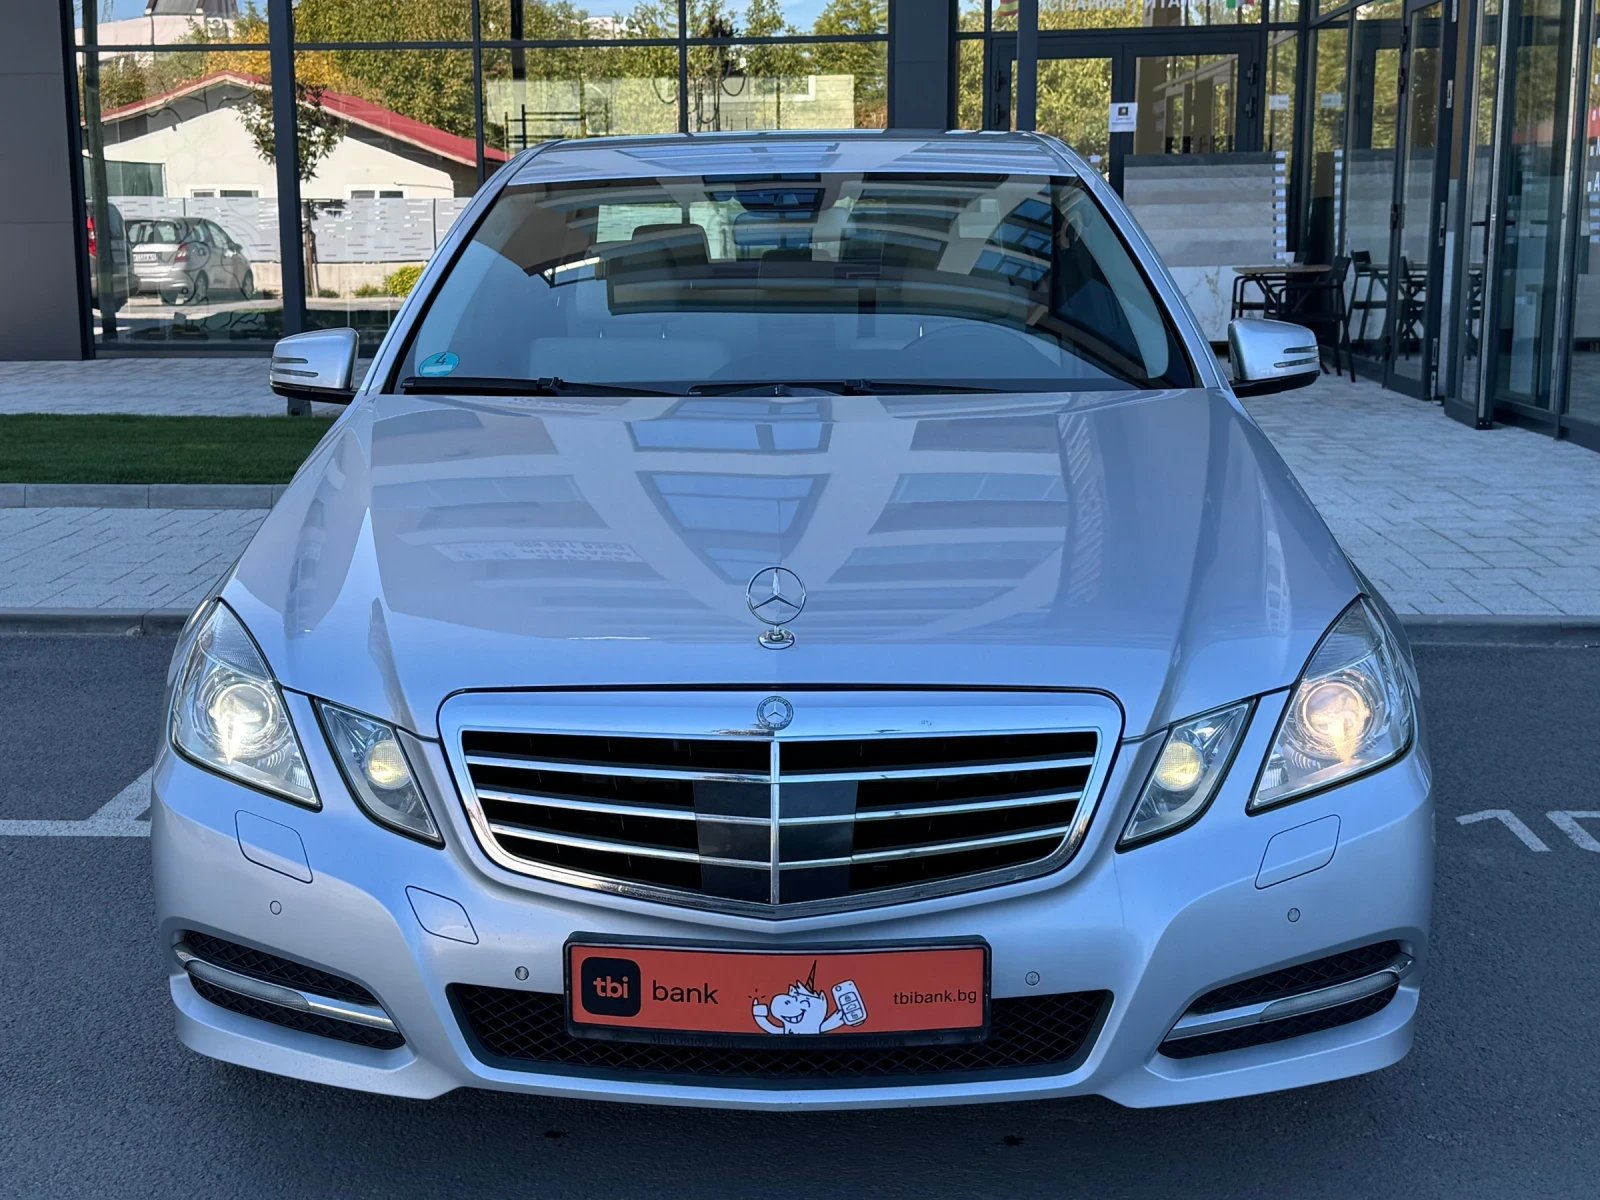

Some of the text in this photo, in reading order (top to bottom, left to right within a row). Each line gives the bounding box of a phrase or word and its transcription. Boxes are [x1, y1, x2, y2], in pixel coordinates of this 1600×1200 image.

[435, 352, 447, 365] 4
[592, 975, 719, 1005] tbi bank
[893, 988, 977, 1005] tbibank.bg
